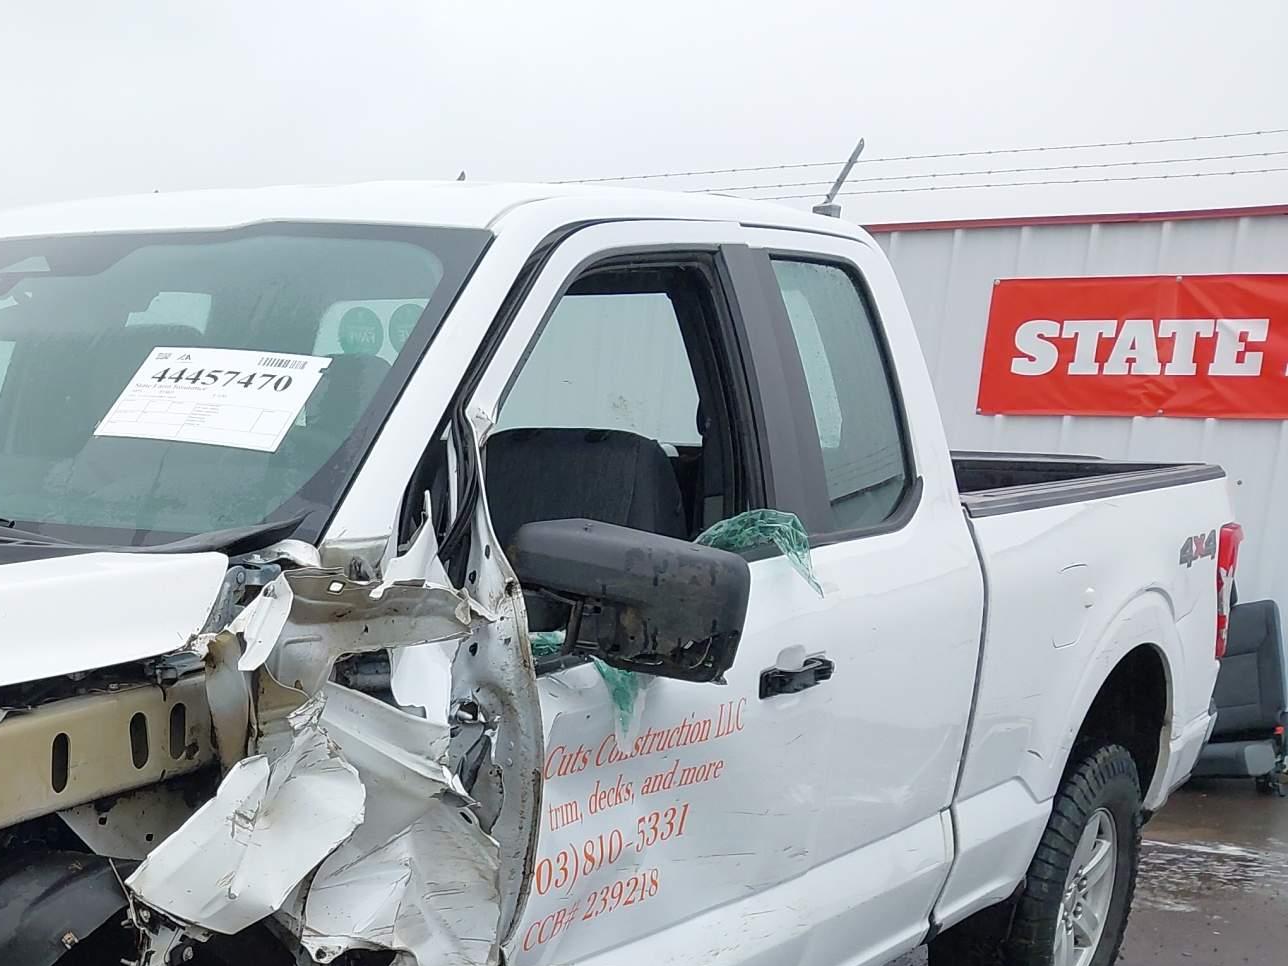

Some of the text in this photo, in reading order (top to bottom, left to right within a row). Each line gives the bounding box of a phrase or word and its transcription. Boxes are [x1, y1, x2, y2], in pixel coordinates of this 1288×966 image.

[151, 367, 294, 392] 44457470
[1010, 318, 1270, 377] STATE
[543, 697, 748, 780] Cuts Costruction LLC
[548, 759, 724, 832] trim, decks, and more
[523, 868, 659, 951] CCB# 239218
